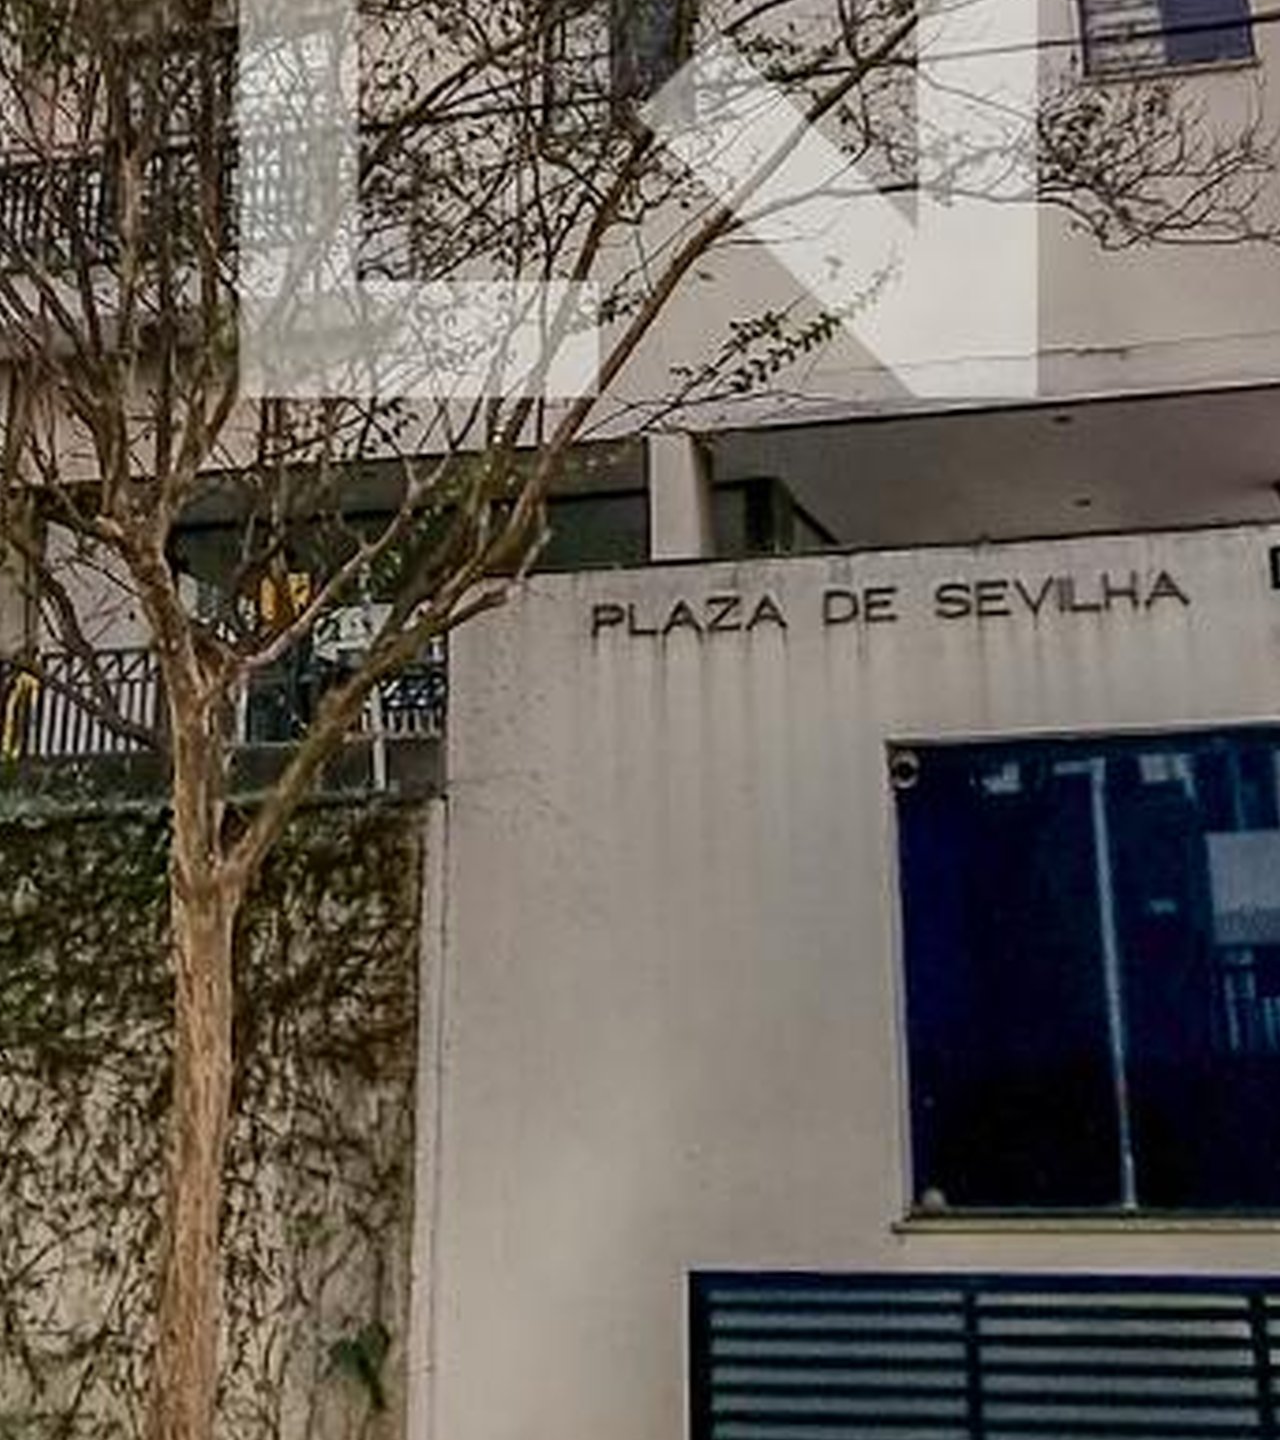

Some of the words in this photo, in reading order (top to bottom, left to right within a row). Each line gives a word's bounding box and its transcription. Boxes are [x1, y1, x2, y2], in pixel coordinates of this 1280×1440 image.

[592, 595, 787, 638] PLAZA
[822, 587, 898, 625] DE
[934, 571, 1190, 619] SEVILHA
